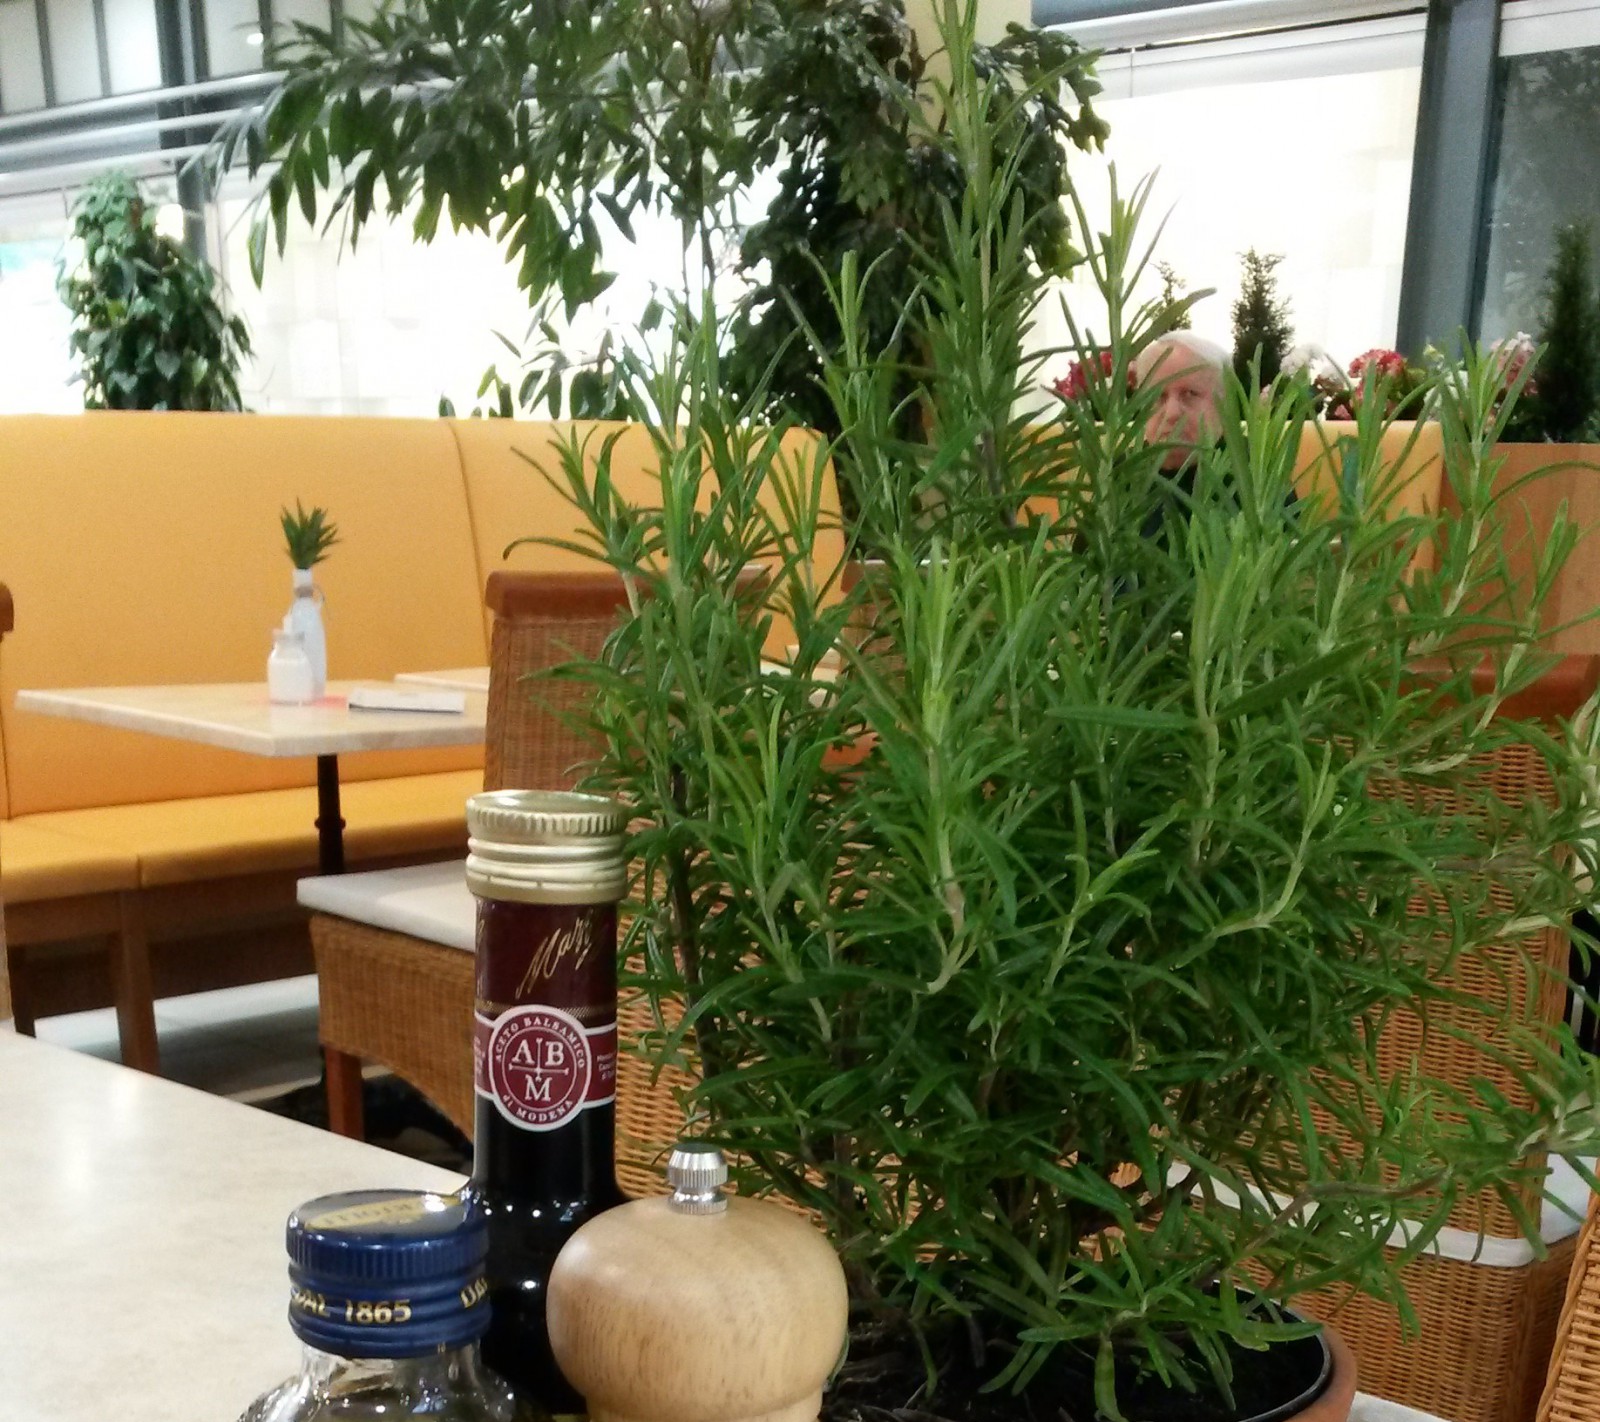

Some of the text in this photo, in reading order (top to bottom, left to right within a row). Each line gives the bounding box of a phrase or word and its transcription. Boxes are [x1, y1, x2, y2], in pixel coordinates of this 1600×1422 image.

[496, 1022, 519, 1062] ACETO
[523, 1016, 585, 1068] BALSAMICO
[525, 1074, 552, 1102] M
[516, 1100, 573, 1122] MODENA
[345, 1299, 412, 1325] 1865
